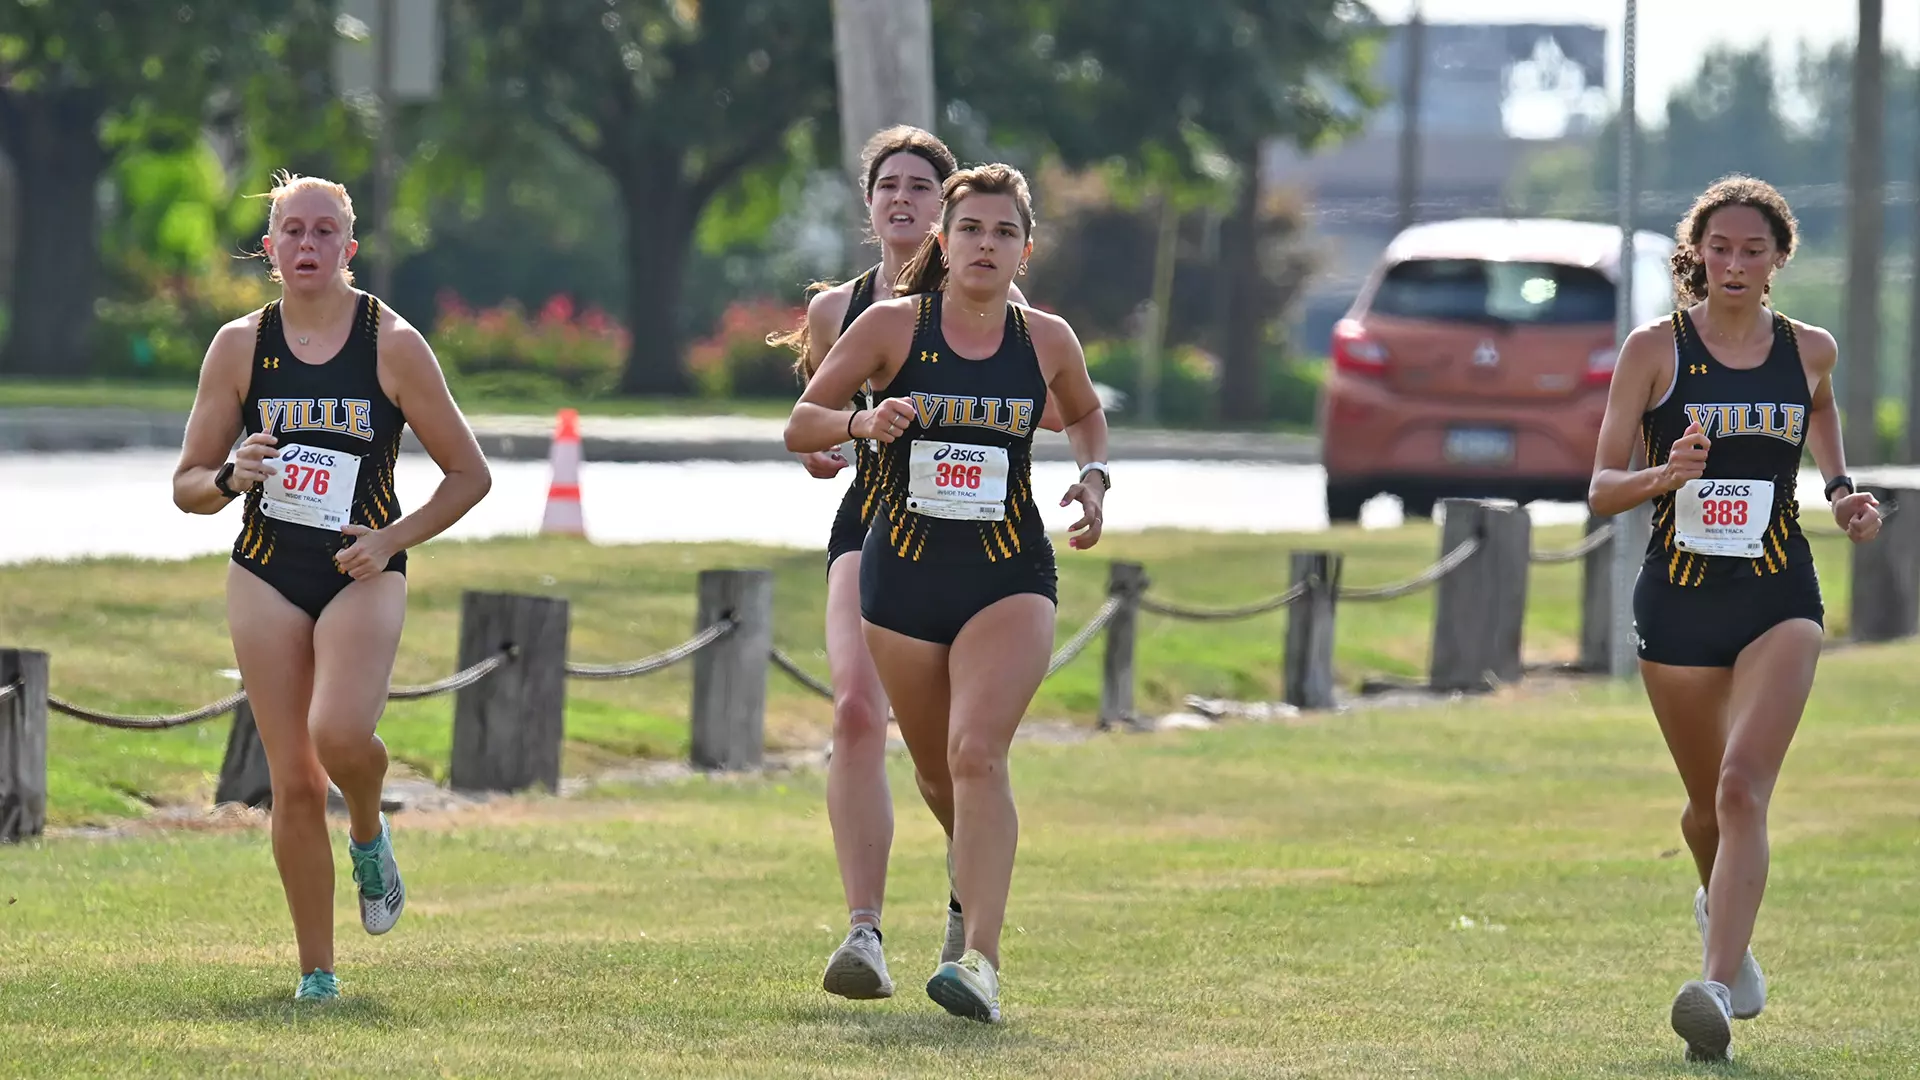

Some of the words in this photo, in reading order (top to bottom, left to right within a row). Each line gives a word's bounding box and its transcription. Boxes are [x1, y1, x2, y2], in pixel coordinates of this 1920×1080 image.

[258, 398, 374, 442] VILLE
[911, 391, 1033, 438] VILLE
[1684, 403, 1805, 447] VILLE
[282, 464, 330, 496] 376
[935, 462, 982, 490] 366
[1702, 500, 1748, 526] 383
